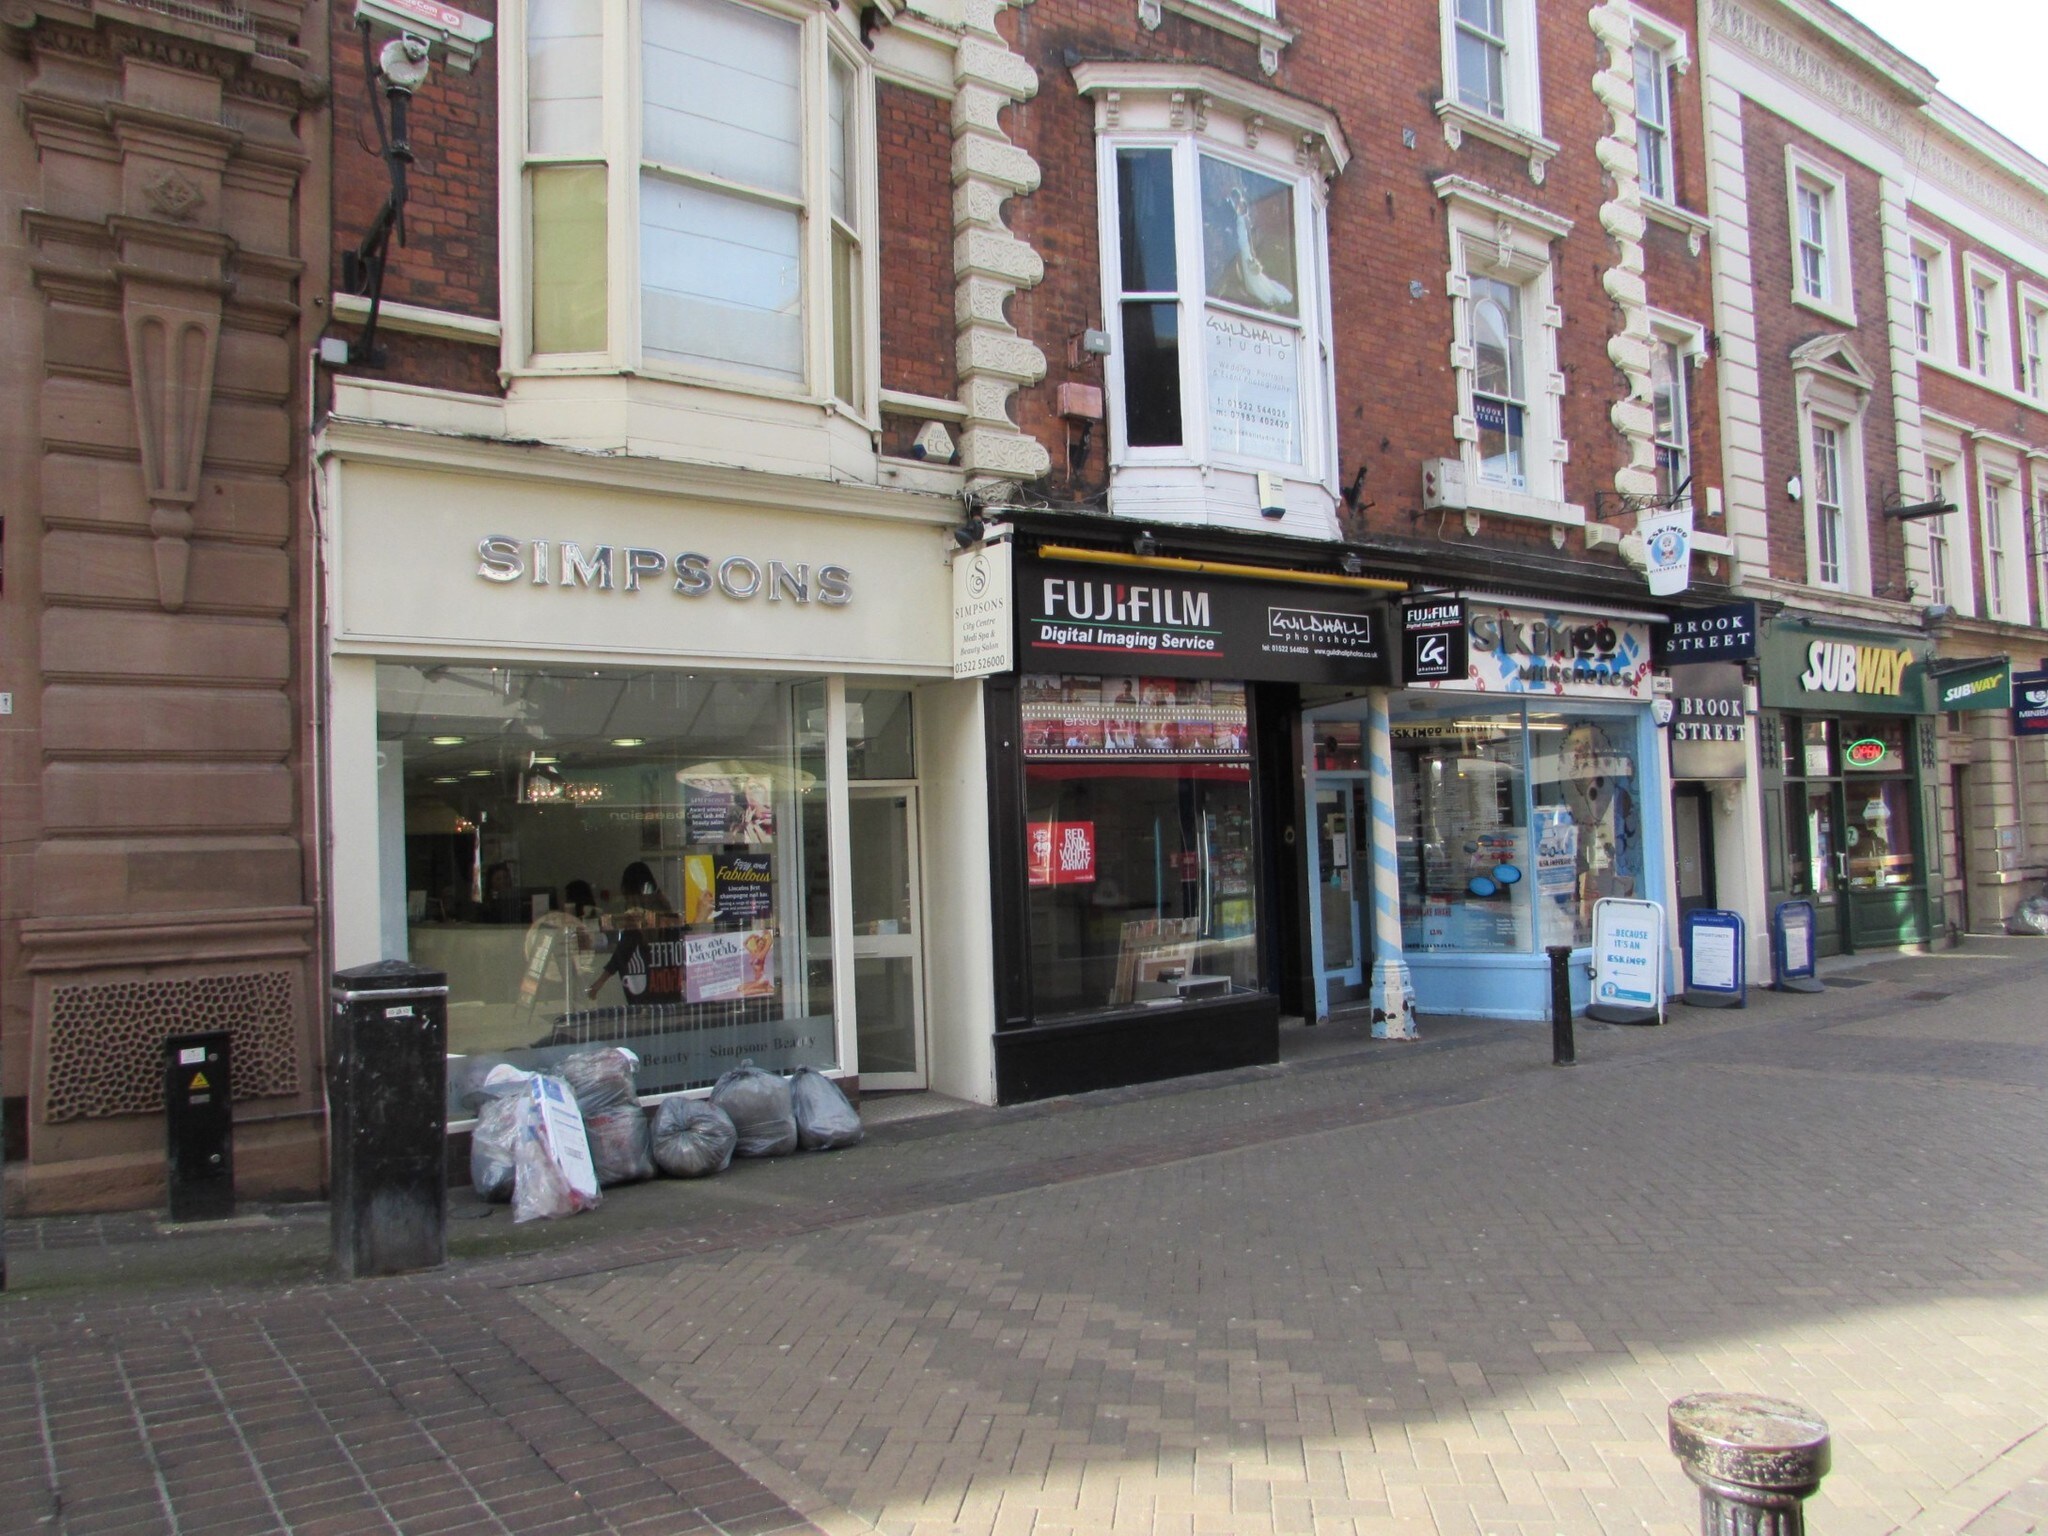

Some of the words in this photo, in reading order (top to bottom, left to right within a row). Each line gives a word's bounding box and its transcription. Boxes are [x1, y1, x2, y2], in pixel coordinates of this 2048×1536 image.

[1206, 315, 1290, 347] GUILDHALL
[1216, 335, 1285, 360] studio
[1228, 400, 1252, 411] 01522
[1476, 404, 1502, 416] BROOK
[1474, 412, 1504, 425] STREET
[928, 438, 951, 454] ECS
[477, 533, 853, 606] SIMPSONS
[955, 597, 1004, 619] SIMPSONS
[1043, 578, 1210, 627] FUJIFILM
[1407, 605, 1459, 621] FUJIFILM
[963, 622, 974, 631] City
[976, 618, 996, 628] Centre
[1272, 612, 1366, 635] GUILDHALL
[1674, 616, 1744, 635] BROOK
[978, 632, 989, 641] Spa
[1040, 625, 1094, 644] Digital
[1097, 628, 1159, 649] Imaging
[1161, 633, 1215, 650] Service
[1285, 632, 1356, 646] photoshop
[1666, 632, 1750, 652] STREET
[960, 646, 981, 655] Beauty
[982, 642, 999, 652] Salon
[1271, 645, 1288, 653] 01522
[955, 660, 976, 674] 01522
[978, 655, 1005, 669] 526000
[1801, 640, 1914, 696] SUBWAY
[1944, 673, 2003, 703] SUBWAY
[1680, 697, 1741, 717] BROOK
[1676, 722, 1746, 741] STREET
[1852, 745, 1881, 759] OPEN
[1065, 828, 1085, 840] RED
[1064, 838, 1086, 850] AND
[1059, 849, 1091, 860] WHITE
[753, 862, 768, 870] and
[1061, 859, 1091, 871] ARMY
[716, 866, 770, 882] Fabulous
[708, 938, 725, 949] are
[1614, 939, 1629, 949] IT'S
[1629, 942, 1641, 950] AN
[643, 1050, 689, 1067] Beauty
[710, 1039, 768, 1059] Simpsons
[773, 1034, 816, 1052] Beauty
